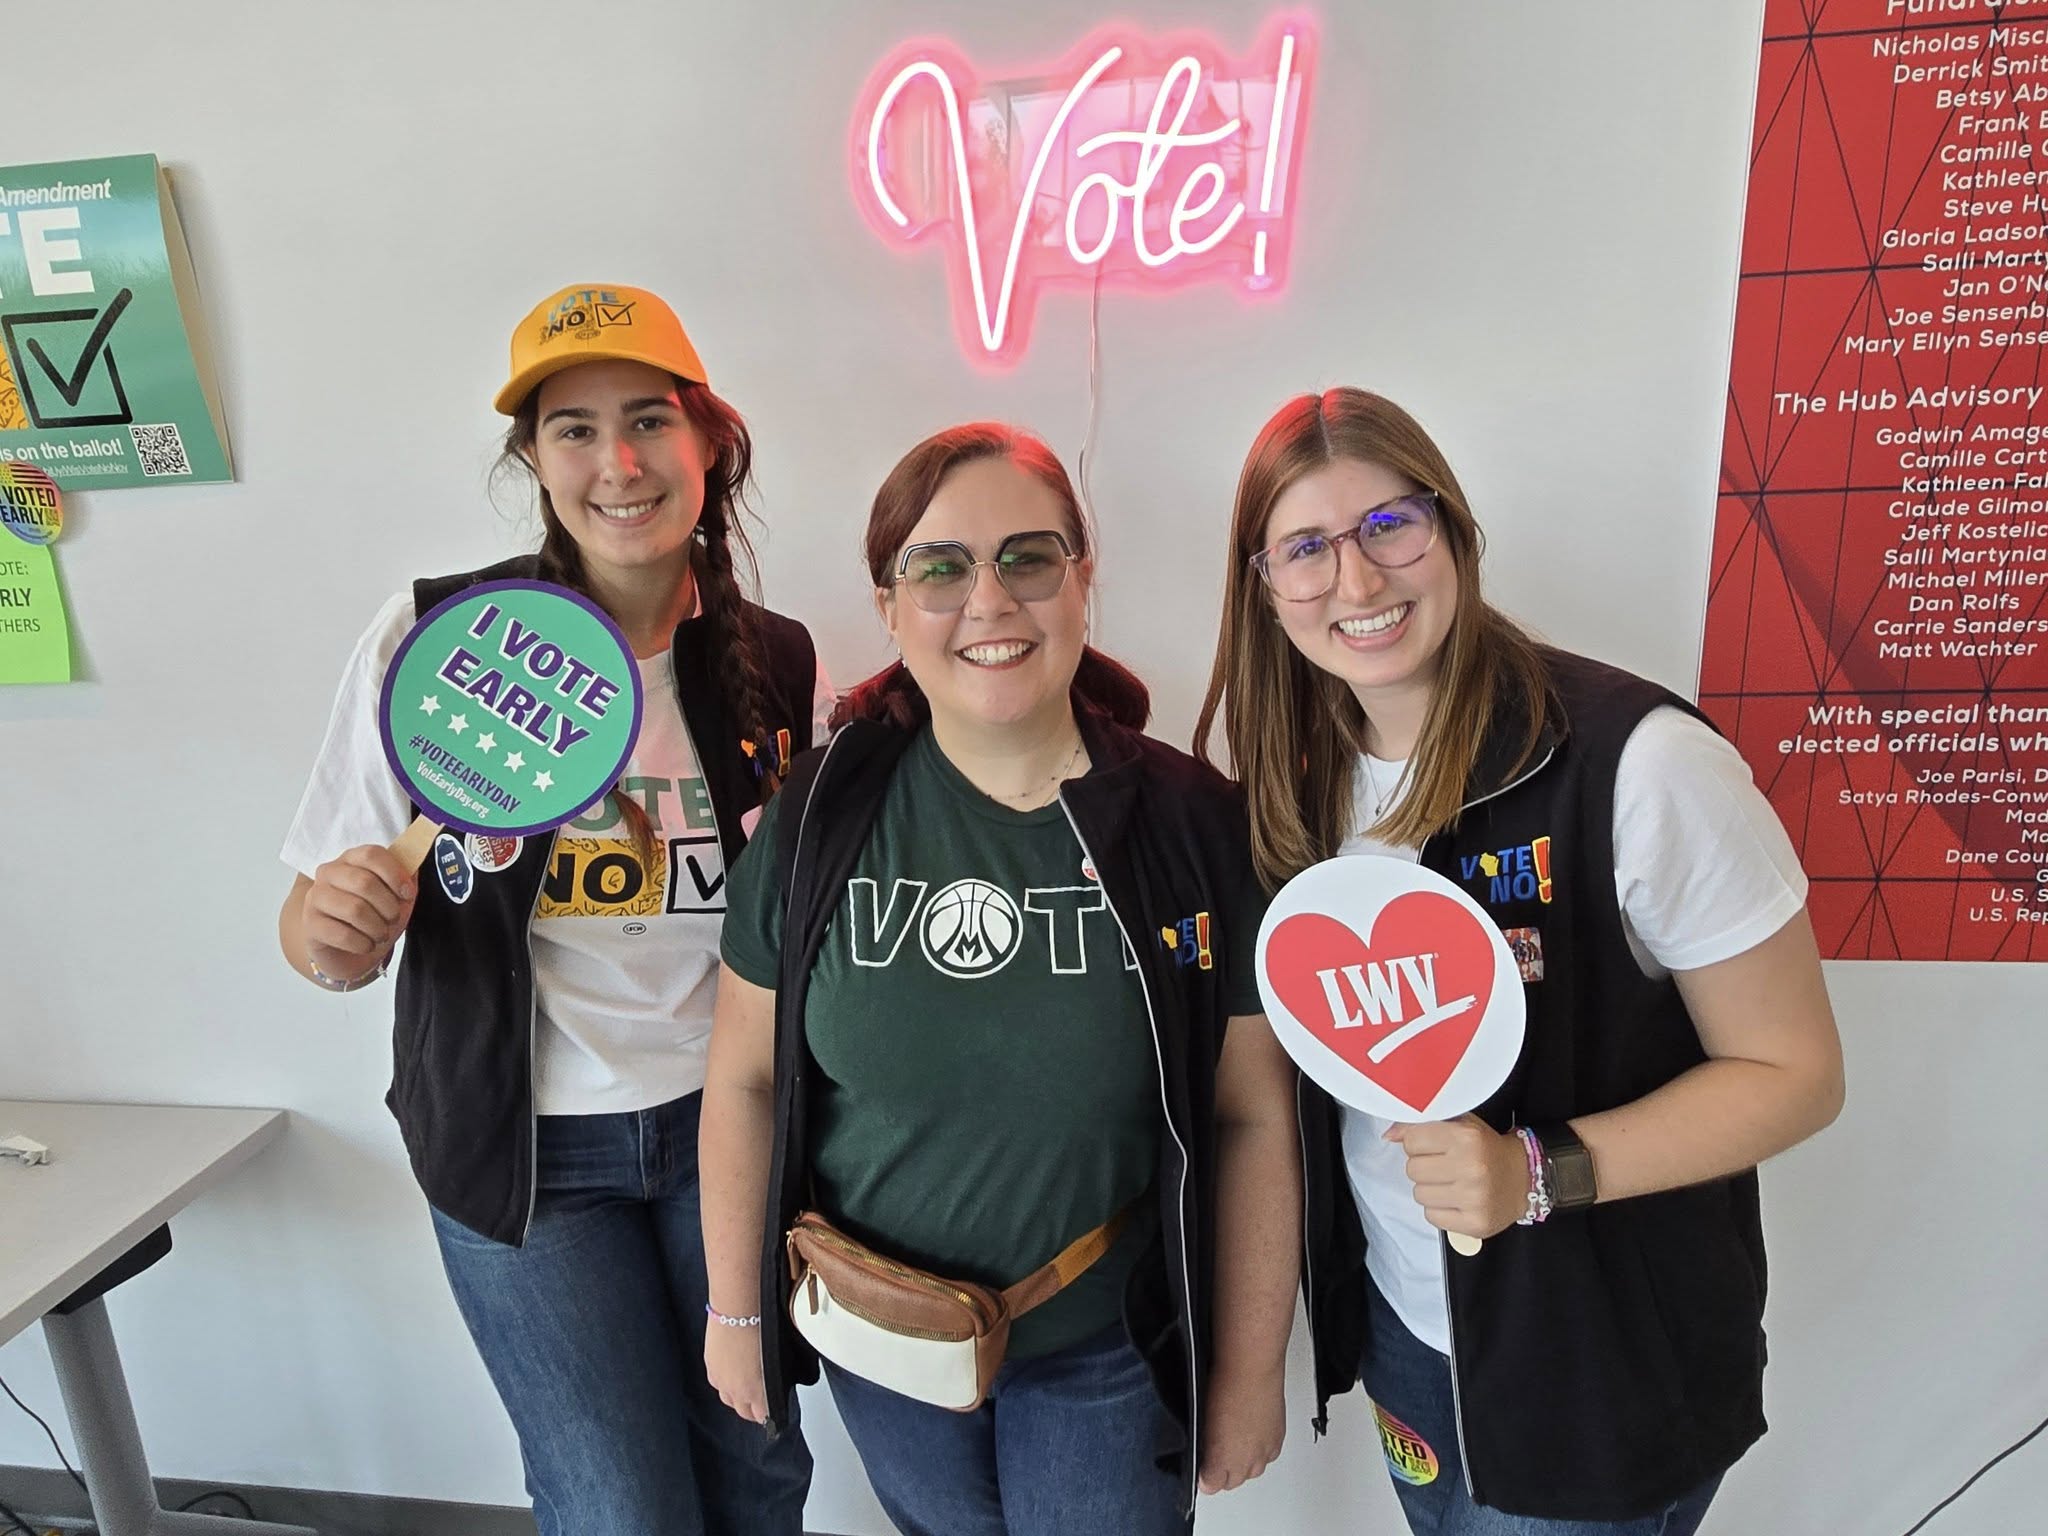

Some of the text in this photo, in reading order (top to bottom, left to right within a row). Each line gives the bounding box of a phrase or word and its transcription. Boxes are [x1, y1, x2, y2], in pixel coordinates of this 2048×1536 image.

[1873, 27, 2048, 57] Nicholas Misc
[1894, 58, 1984, 84] Derrick
[1936, 88, 2007, 110] Betsy
[1959, 111, 2031, 135] Frank
[1940, 140, 2032, 163] Camille
[1943, 168, 2048, 191] Kathleen
[868, 34, 1295, 351] Vote!
[1943, 198, 2013, 218] Steve
[1882, 226, 1956, 248] Gloria
[1922, 251, 1976, 272] Salli
[1943, 278, 1990, 297] Jan
[548, 310, 586, 338] NO
[1888, 307, 1933, 326] Joe
[1845, 335, 1906, 357] Mary
[1912, 332, 1971, 354] Ellyn
[1774, 384, 2044, 415] The Hub Advisory
[1876, 425, 1963, 446] Godwin
[16, 446, 40, 460] on
[40, 442, 69, 460] the
[69, 438, 124, 458] ballot!
[1900, 449, 1986, 469] Camille
[1902, 474, 2005, 494] Kathleen
[2, 486, 56, 507] VOTED
[0, 505, 44, 525] EARLY
[1888, 499, 1970, 518] Claude
[1901, 523, 1952, 541] Jeff
[1883, 545, 2047, 567] Salli Martynia
[1888, 569, 2048, 590] Michael Miller
[1909, 593, 2020, 612] Dan Rolfs
[1874, 616, 2048, 636] Carrie Sanders
[1879, 640, 2038, 659] Matt Wachter
[467, 602, 621, 720] I VOTE
[435, 645, 592, 758] EARLY
[1808, 703, 2048, 729] With special than
[1778, 733, 1881, 754] elected
[1887, 732, 2000, 753] officials
[408, 734, 522, 814] #VOTEEARLYDAY
[1916, 768, 1955, 784] Joe
[1962, 767, 2027, 785] Parisi,
[416, 760, 490, 819] VoteEarlyDay.org
[1838, 789, 1898, 807] Satya
[2005, 808, 2048, 823] Mad
[1946, 849, 1999, 864] Dane
[1991, 887, 2029, 903] U.S.
[1969, 907, 2008, 922] U.S.
[1316, 953, 1437, 1029] LWV
